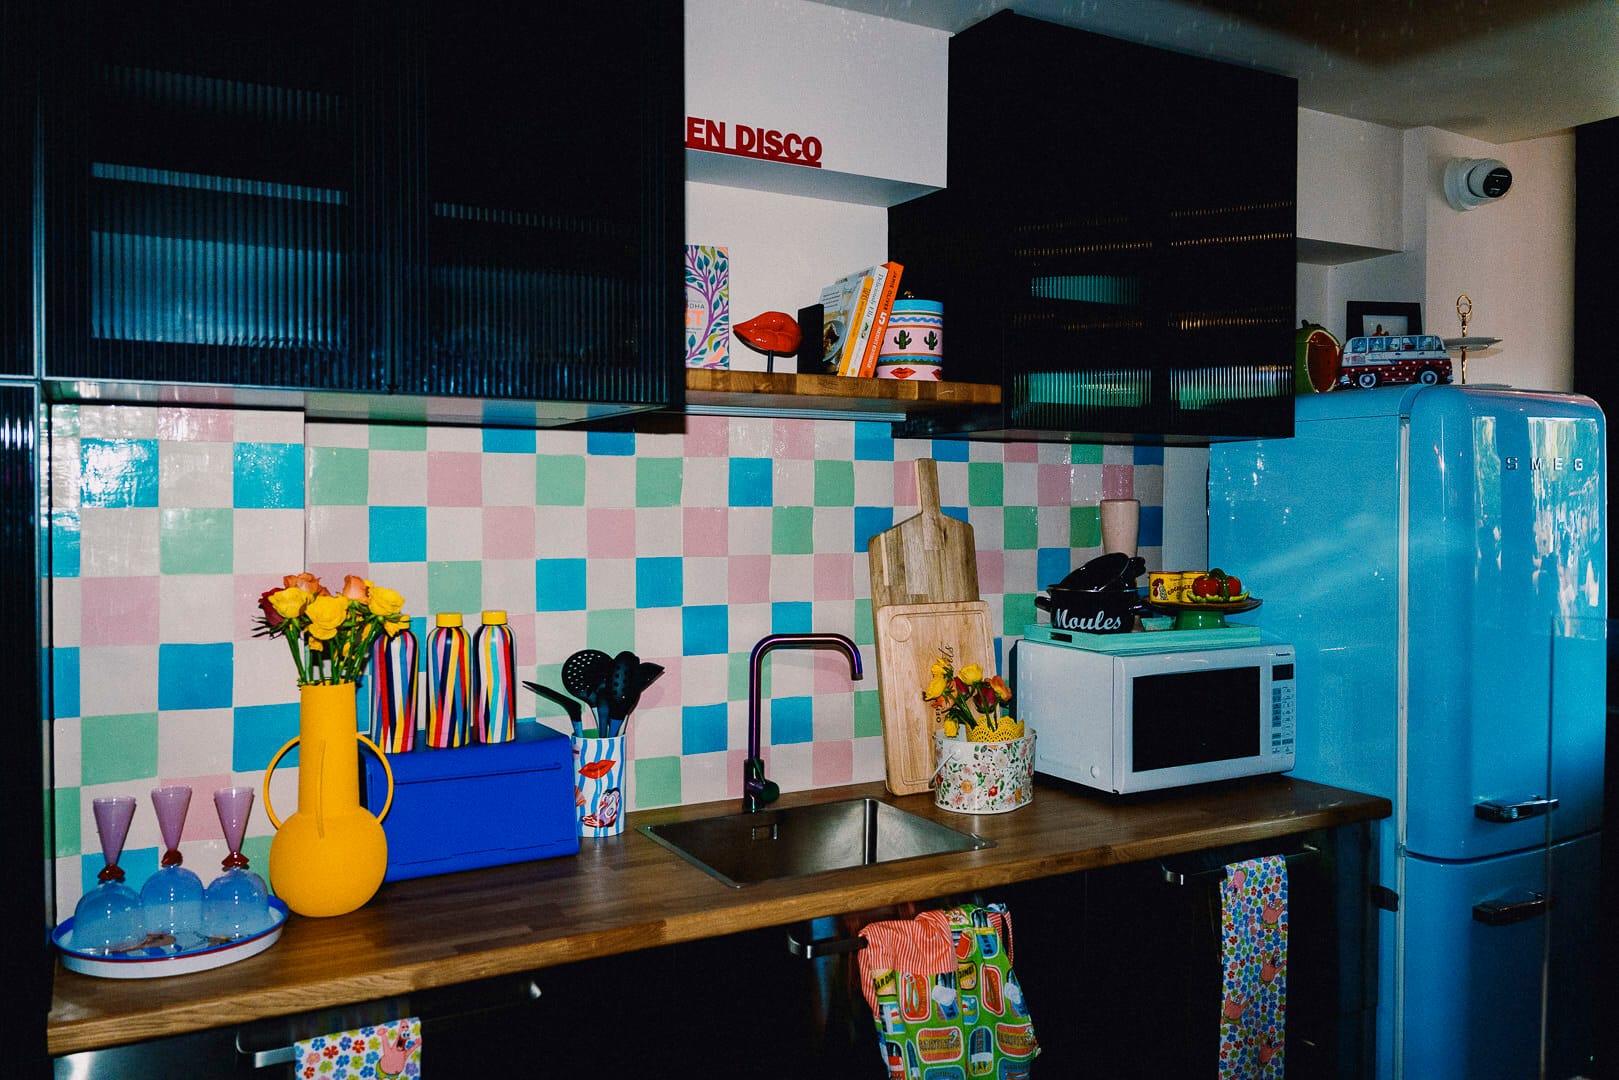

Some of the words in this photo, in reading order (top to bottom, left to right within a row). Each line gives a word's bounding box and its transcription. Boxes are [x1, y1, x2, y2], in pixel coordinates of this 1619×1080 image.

[736, 124, 822, 162] DISCO
[884, 291, 893, 310] OLIVER
[1505, 457, 1584, 471] SMEG
[1055, 608, 1122, 630] Moules
